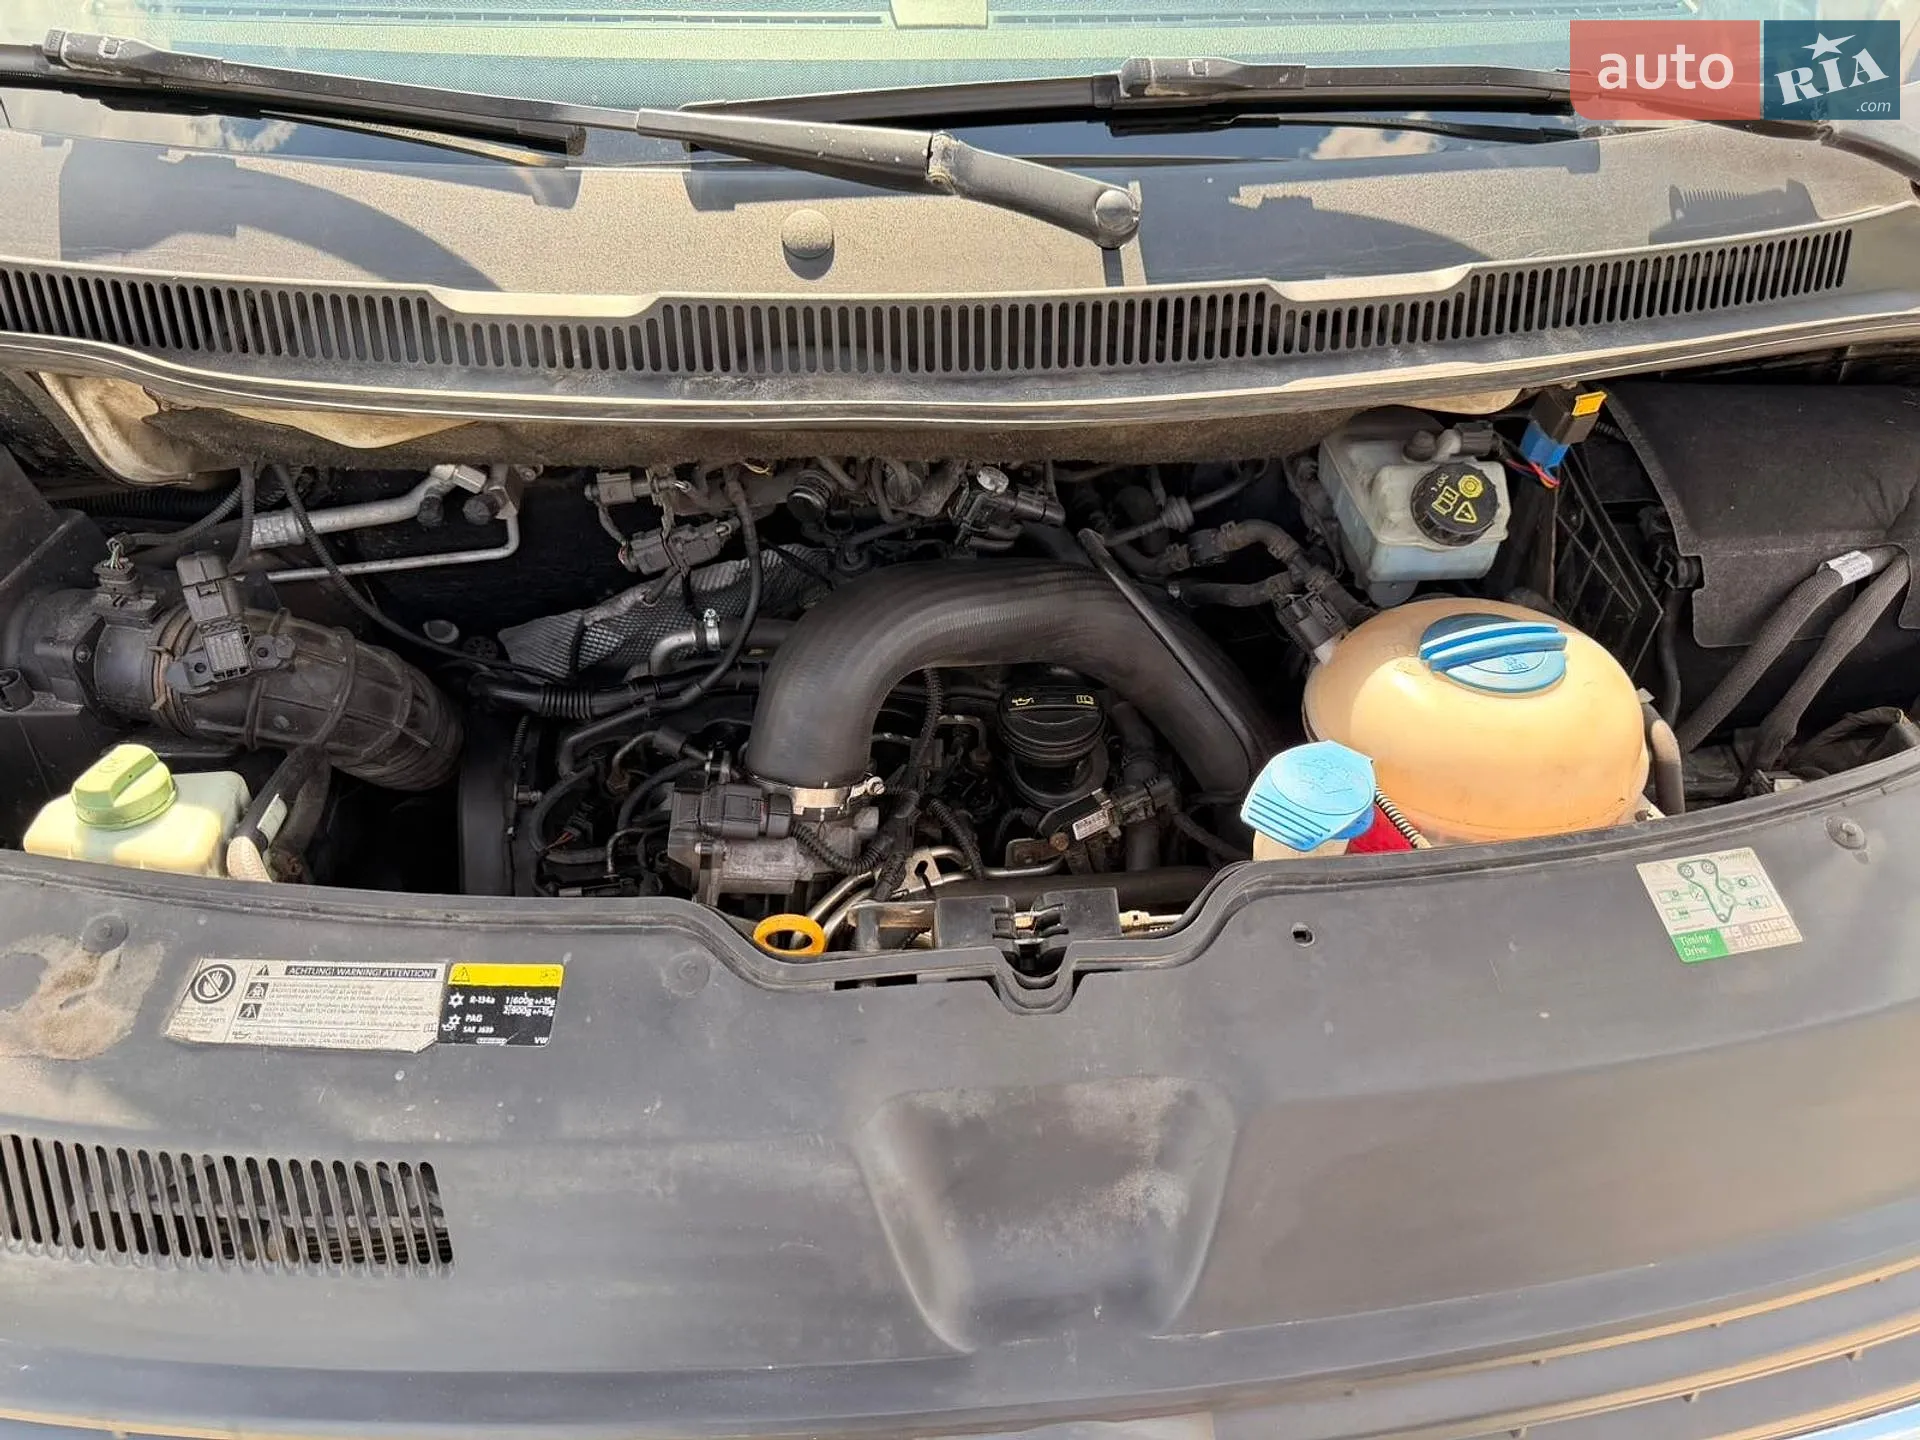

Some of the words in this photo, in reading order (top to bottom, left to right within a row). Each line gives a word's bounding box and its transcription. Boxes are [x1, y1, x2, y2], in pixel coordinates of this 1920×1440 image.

[289, 966, 335, 976] ACHTUNG!
[336, 967, 382, 977] WARNING!
[383, 968, 435, 979] ATTENTION!
[465, 1014, 483, 1023] PAG
